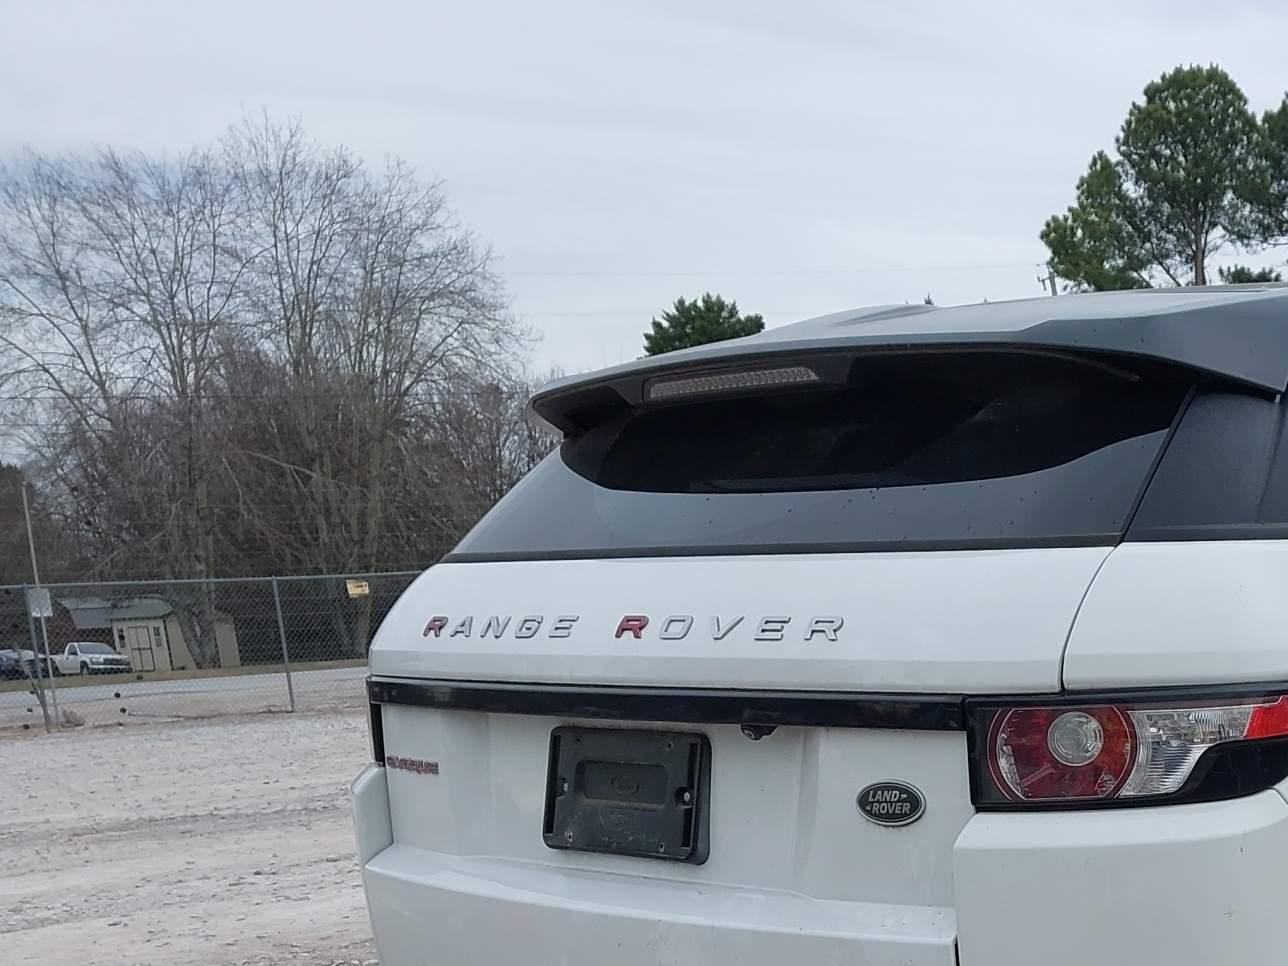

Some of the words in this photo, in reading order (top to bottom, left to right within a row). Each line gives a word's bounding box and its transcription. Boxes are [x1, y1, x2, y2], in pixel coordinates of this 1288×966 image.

[422, 616, 580, 639] RANGE
[614, 614, 845, 642] ROVER
[868, 790, 900, 802] LAND
[871, 802, 911, 814] ROVER
